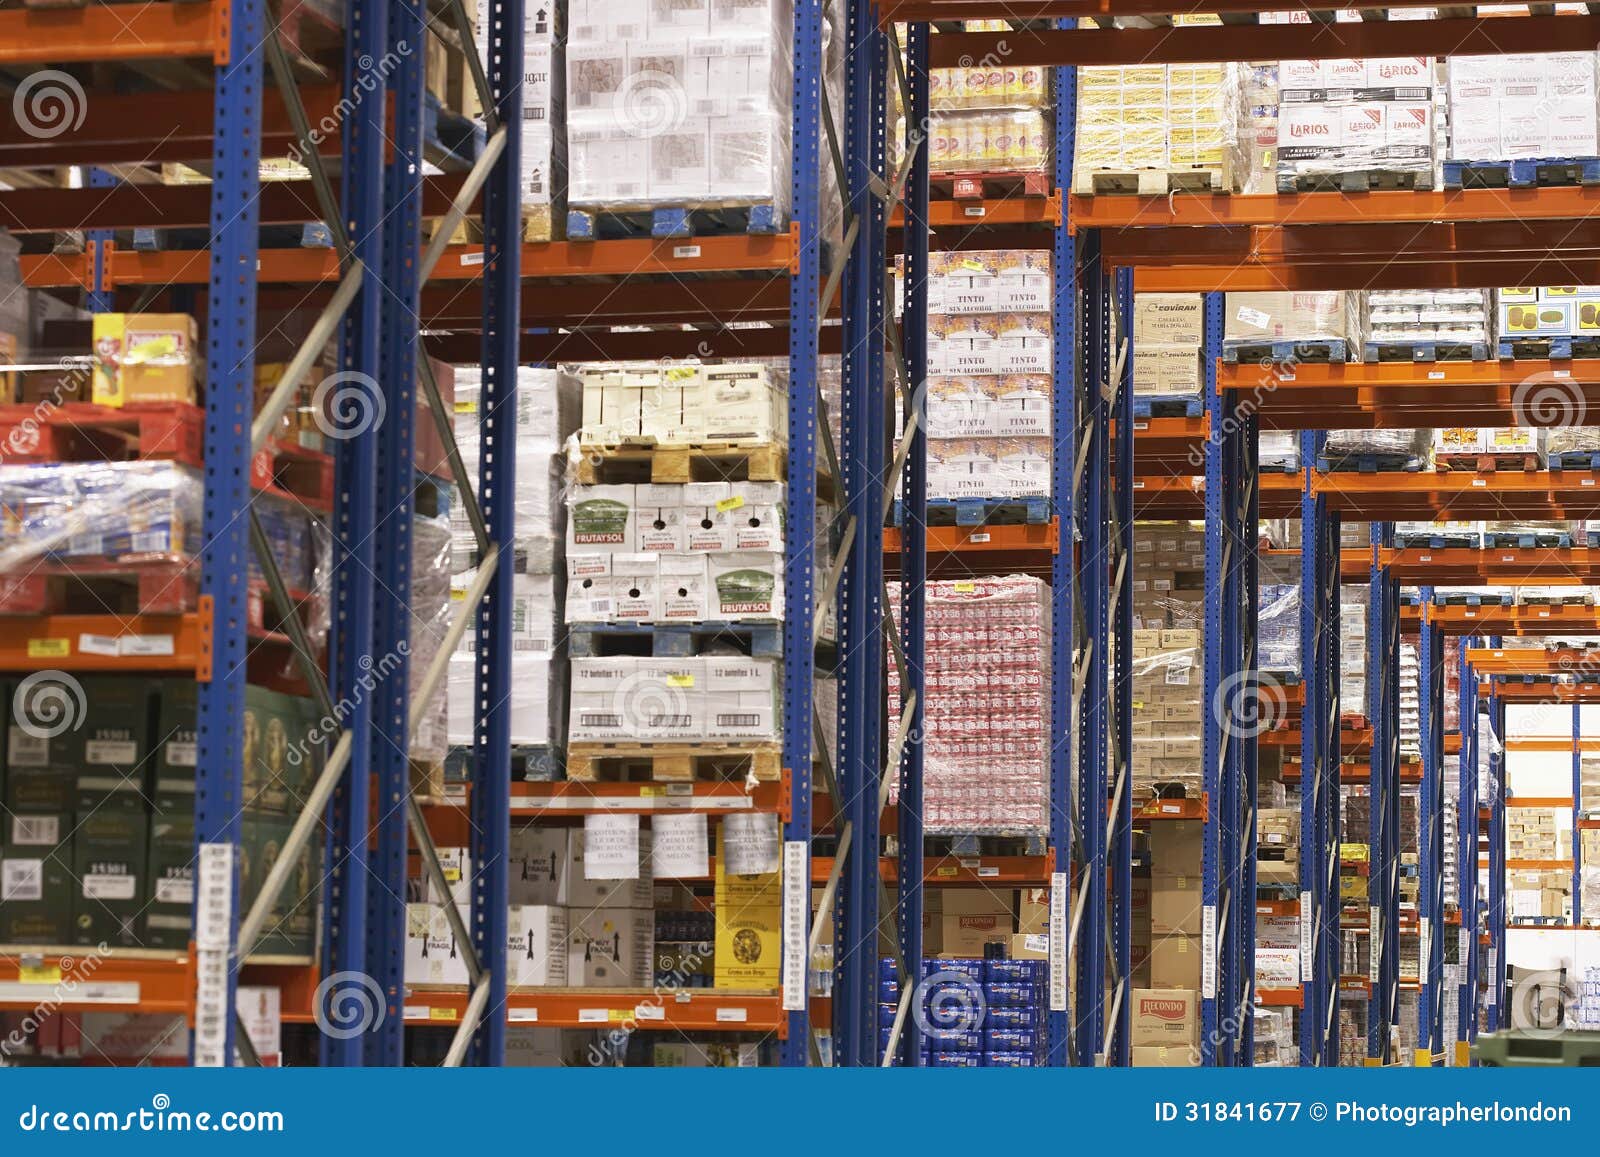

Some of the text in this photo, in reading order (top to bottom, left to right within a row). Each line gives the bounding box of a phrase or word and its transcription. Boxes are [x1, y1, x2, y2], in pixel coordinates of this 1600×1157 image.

[1379, 64, 1419, 78] LARIOS
[1349, 122, 1377, 131] LARIOS
[1394, 121, 1421, 129] LARIOS
[1290, 123, 1329, 137] LARIOS
[576, 534, 624, 543] FRUTAYSOL
[721, 603, 769, 612] FRUTAYSOL
[1143, 1001, 1183, 1012] RECONDO
